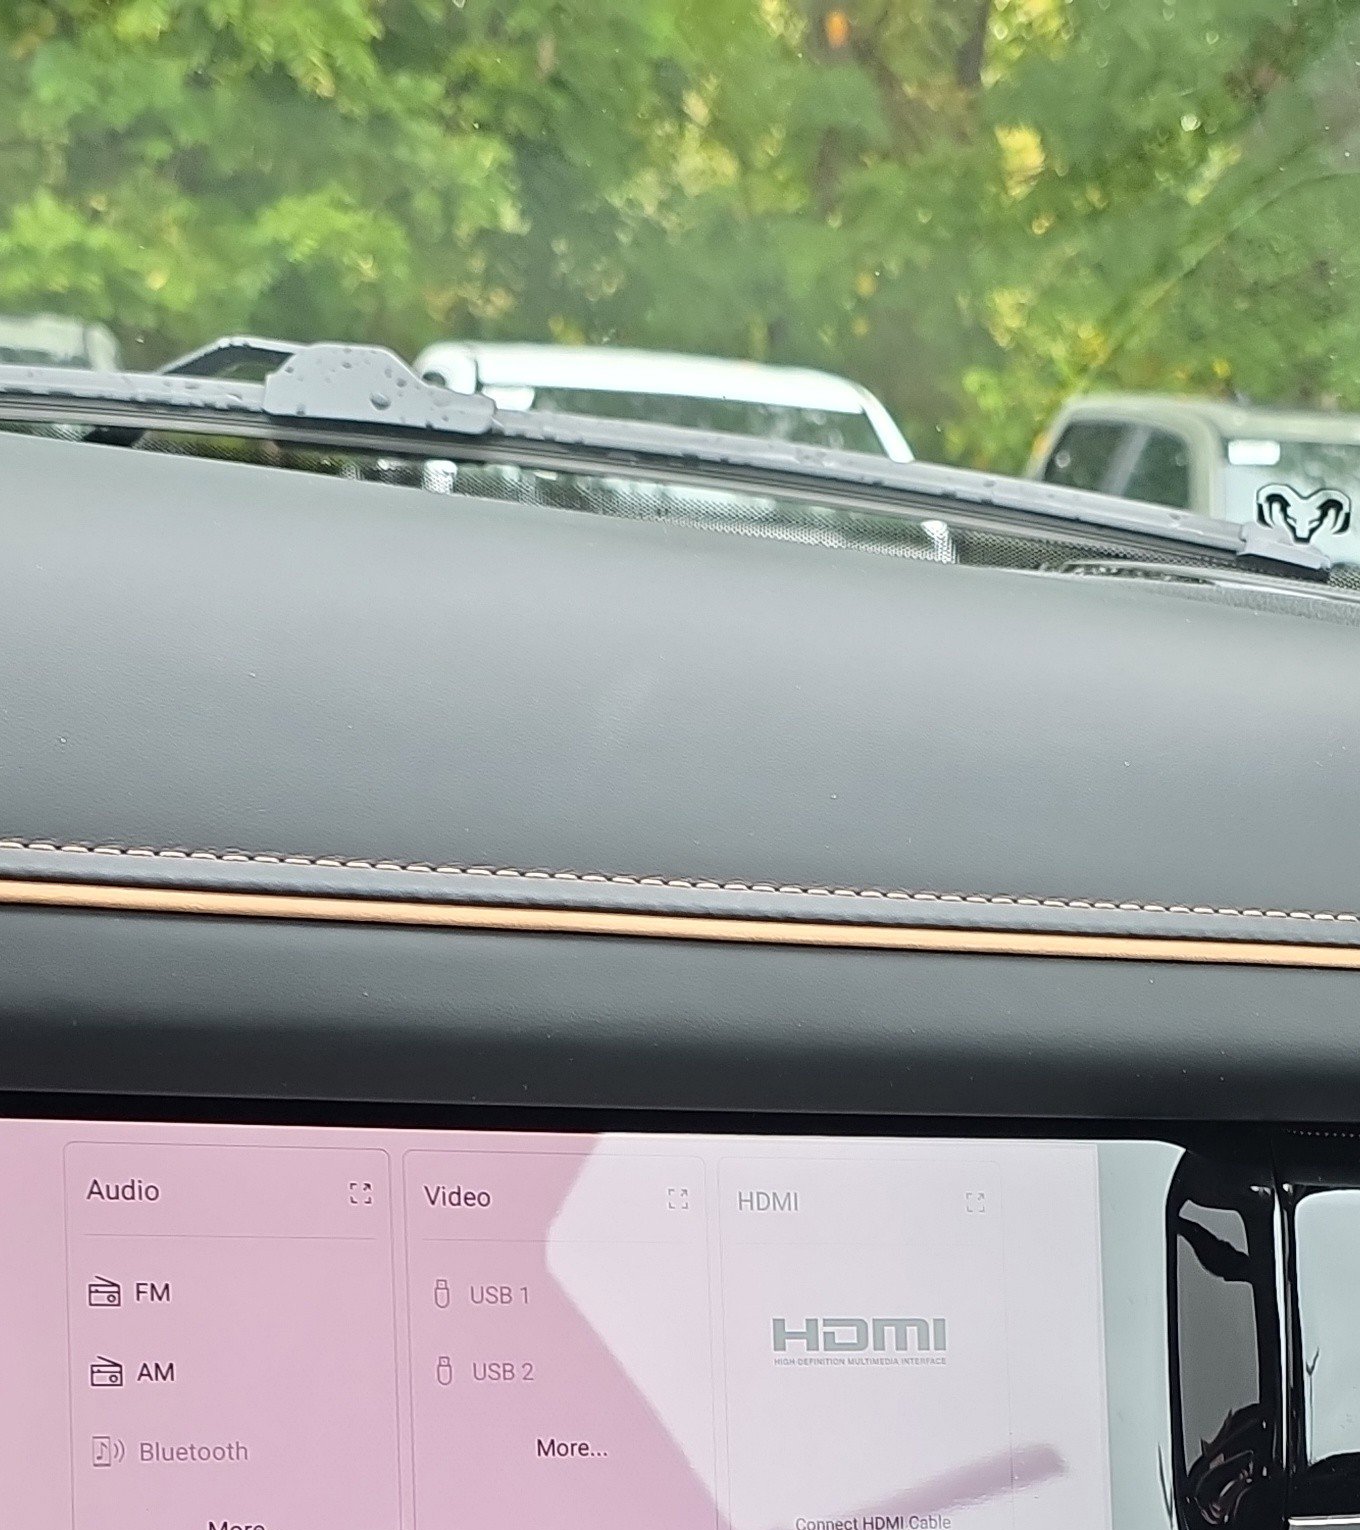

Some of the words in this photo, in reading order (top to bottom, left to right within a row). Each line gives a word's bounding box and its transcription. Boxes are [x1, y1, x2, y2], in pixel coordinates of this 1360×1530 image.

[86, 1179, 161, 1202] Audio
[424, 1184, 492, 1208] Video
[737, 1190, 800, 1212] HDMI
[135, 1282, 172, 1302] FM
[470, 1286, 513, 1305] USB
[519, 1285, 530, 1304] 1
[771, 1317, 947, 1352] HDMI
[847, 1356, 899, 1366] MULTIMEDIA
[901, 1356, 947, 1365] INTERFACE
[137, 1362, 176, 1382] AM
[472, 1363, 516, 1382] USB
[521, 1363, 535, 1382] 2
[139, 1441, 249, 1462] Bluetooth
[536, 1438, 609, 1458] More...
[909, 1515, 952, 1530] Cable
